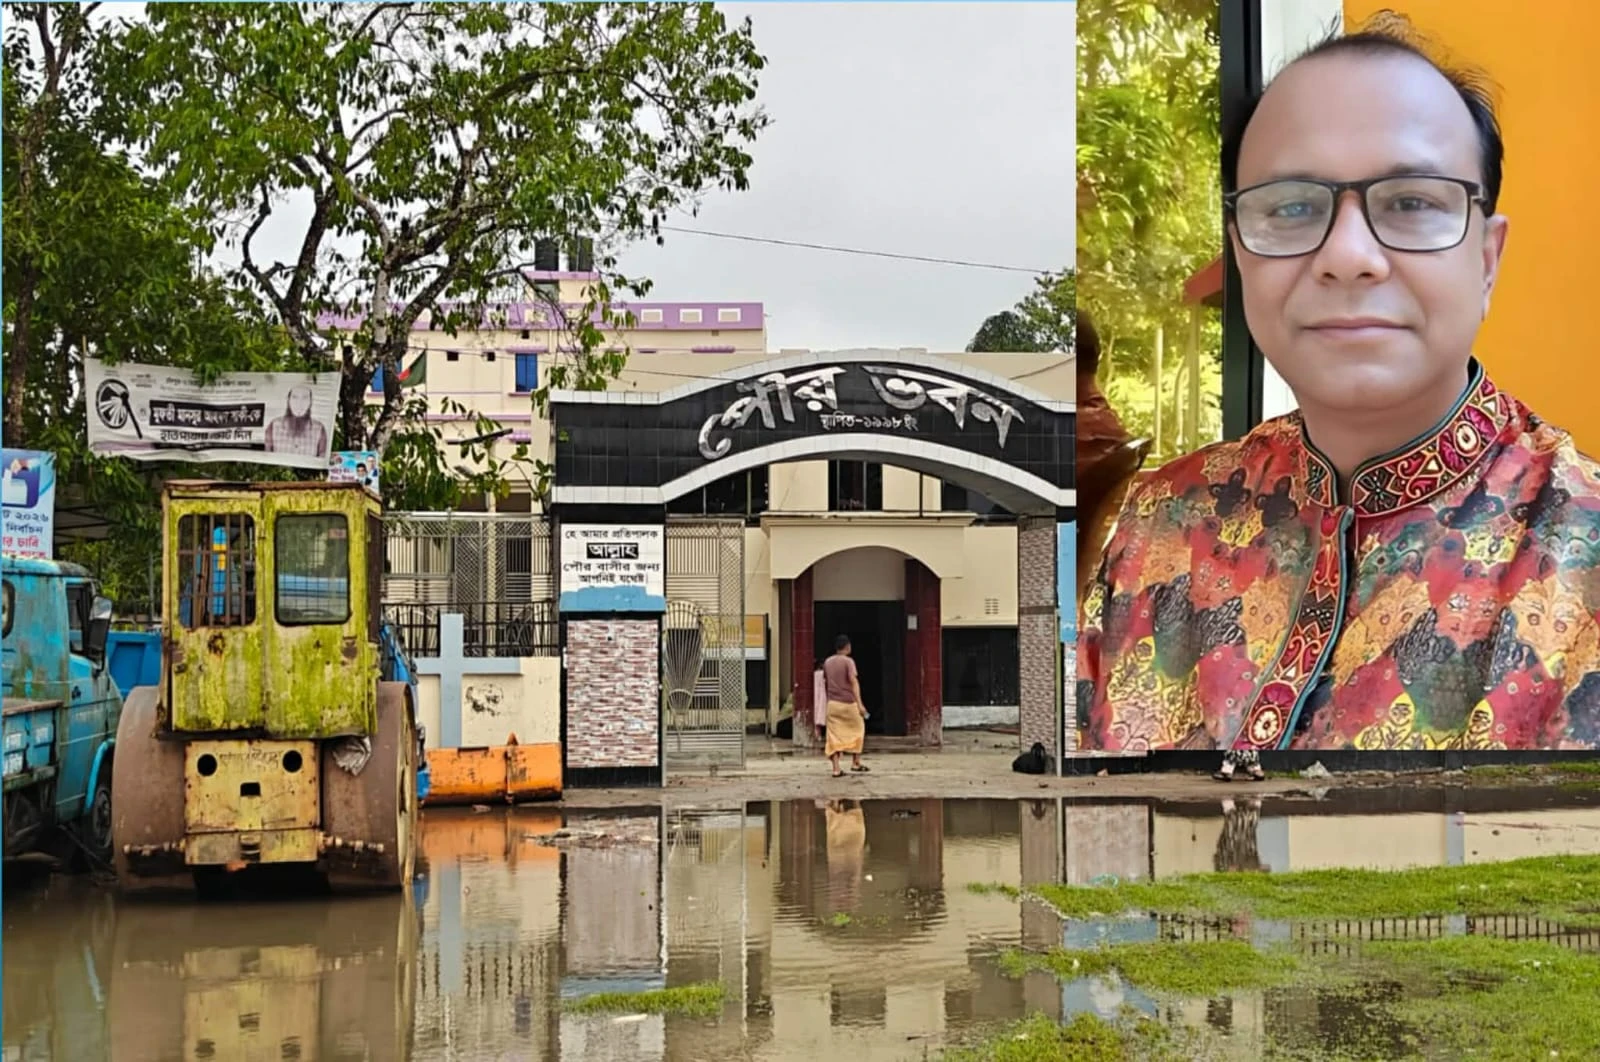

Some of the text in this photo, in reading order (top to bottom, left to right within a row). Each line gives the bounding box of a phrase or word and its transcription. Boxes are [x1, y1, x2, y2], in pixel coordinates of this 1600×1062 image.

[698, 365, 1025, 460] পৌর ভবন
[565, 527, 658, 539] হে আমার প্রতিপালক
[588, 543, 637, 559] আল্লাহ
[563, 560, 591, 572] পৌর
[634, 562, 660, 572] জন্য
